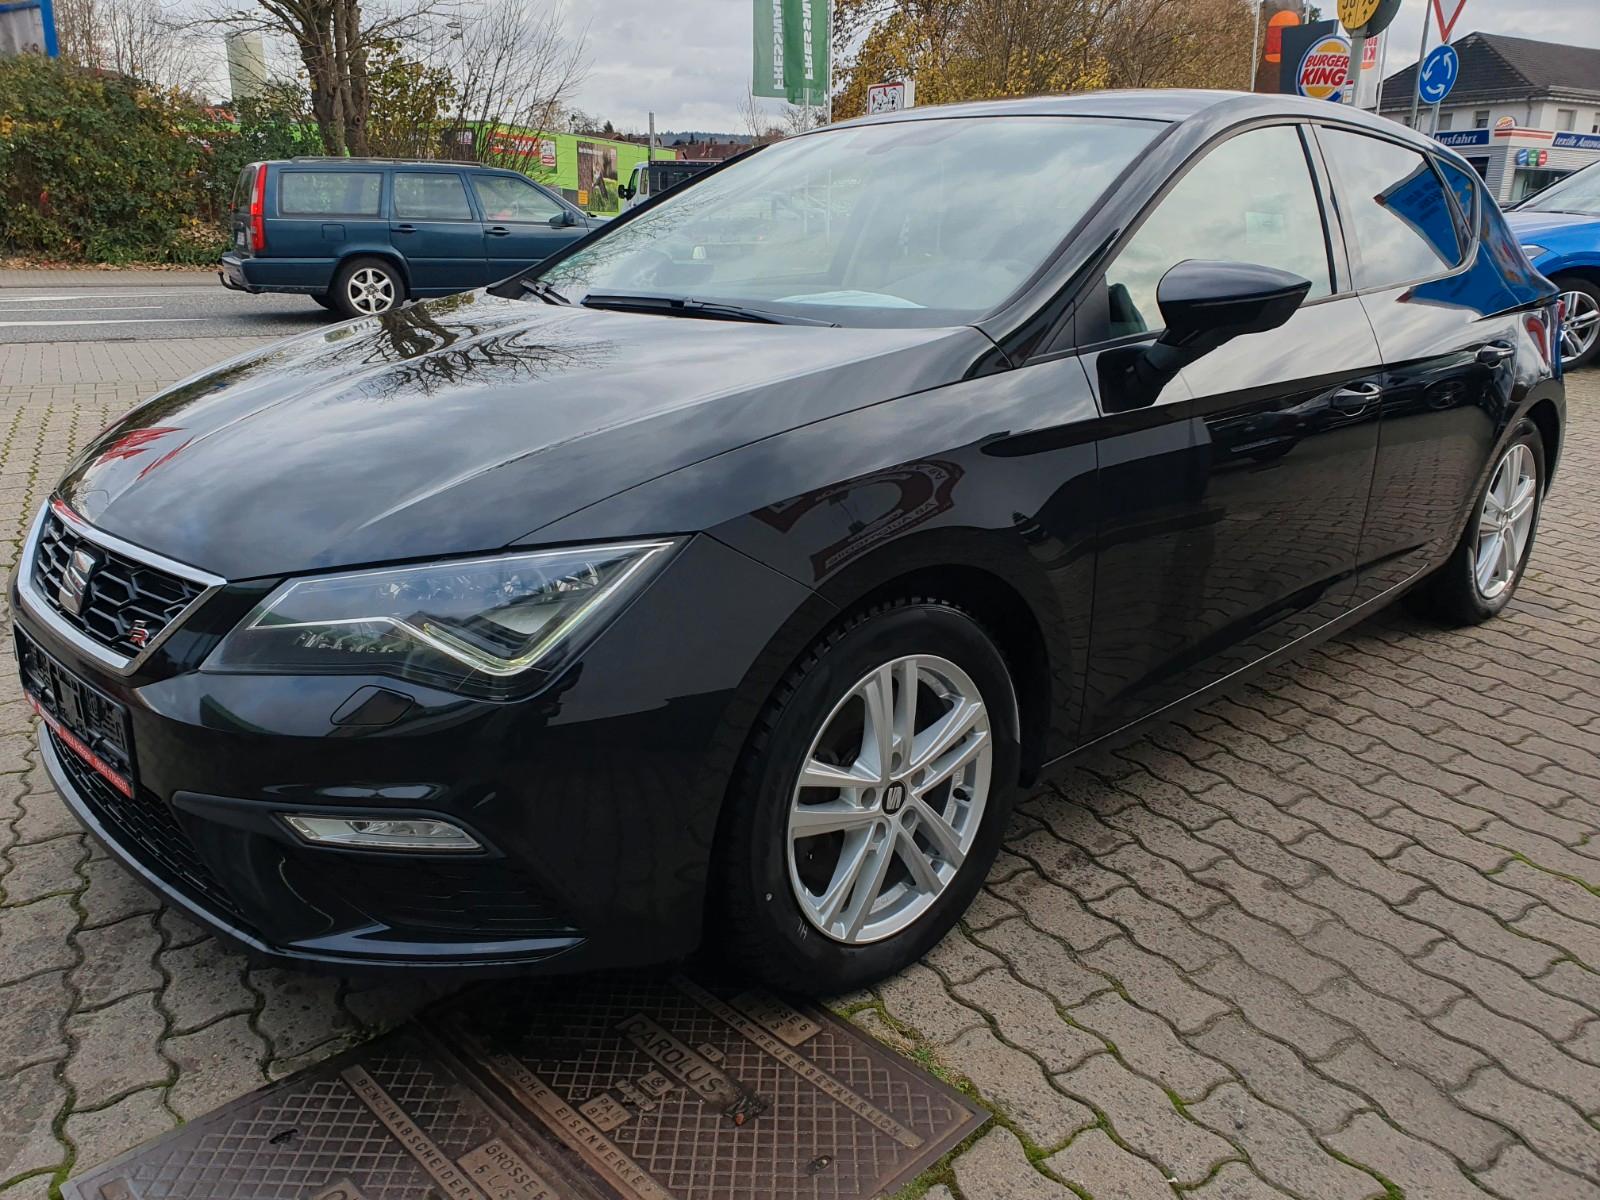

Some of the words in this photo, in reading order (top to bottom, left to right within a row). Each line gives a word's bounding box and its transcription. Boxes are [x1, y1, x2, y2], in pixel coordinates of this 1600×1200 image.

[1304, 55, 1350, 68] BURGER
[1300, 67, 1347, 86] KING
[1435, 133, 1478, 145] Ausfahrt
